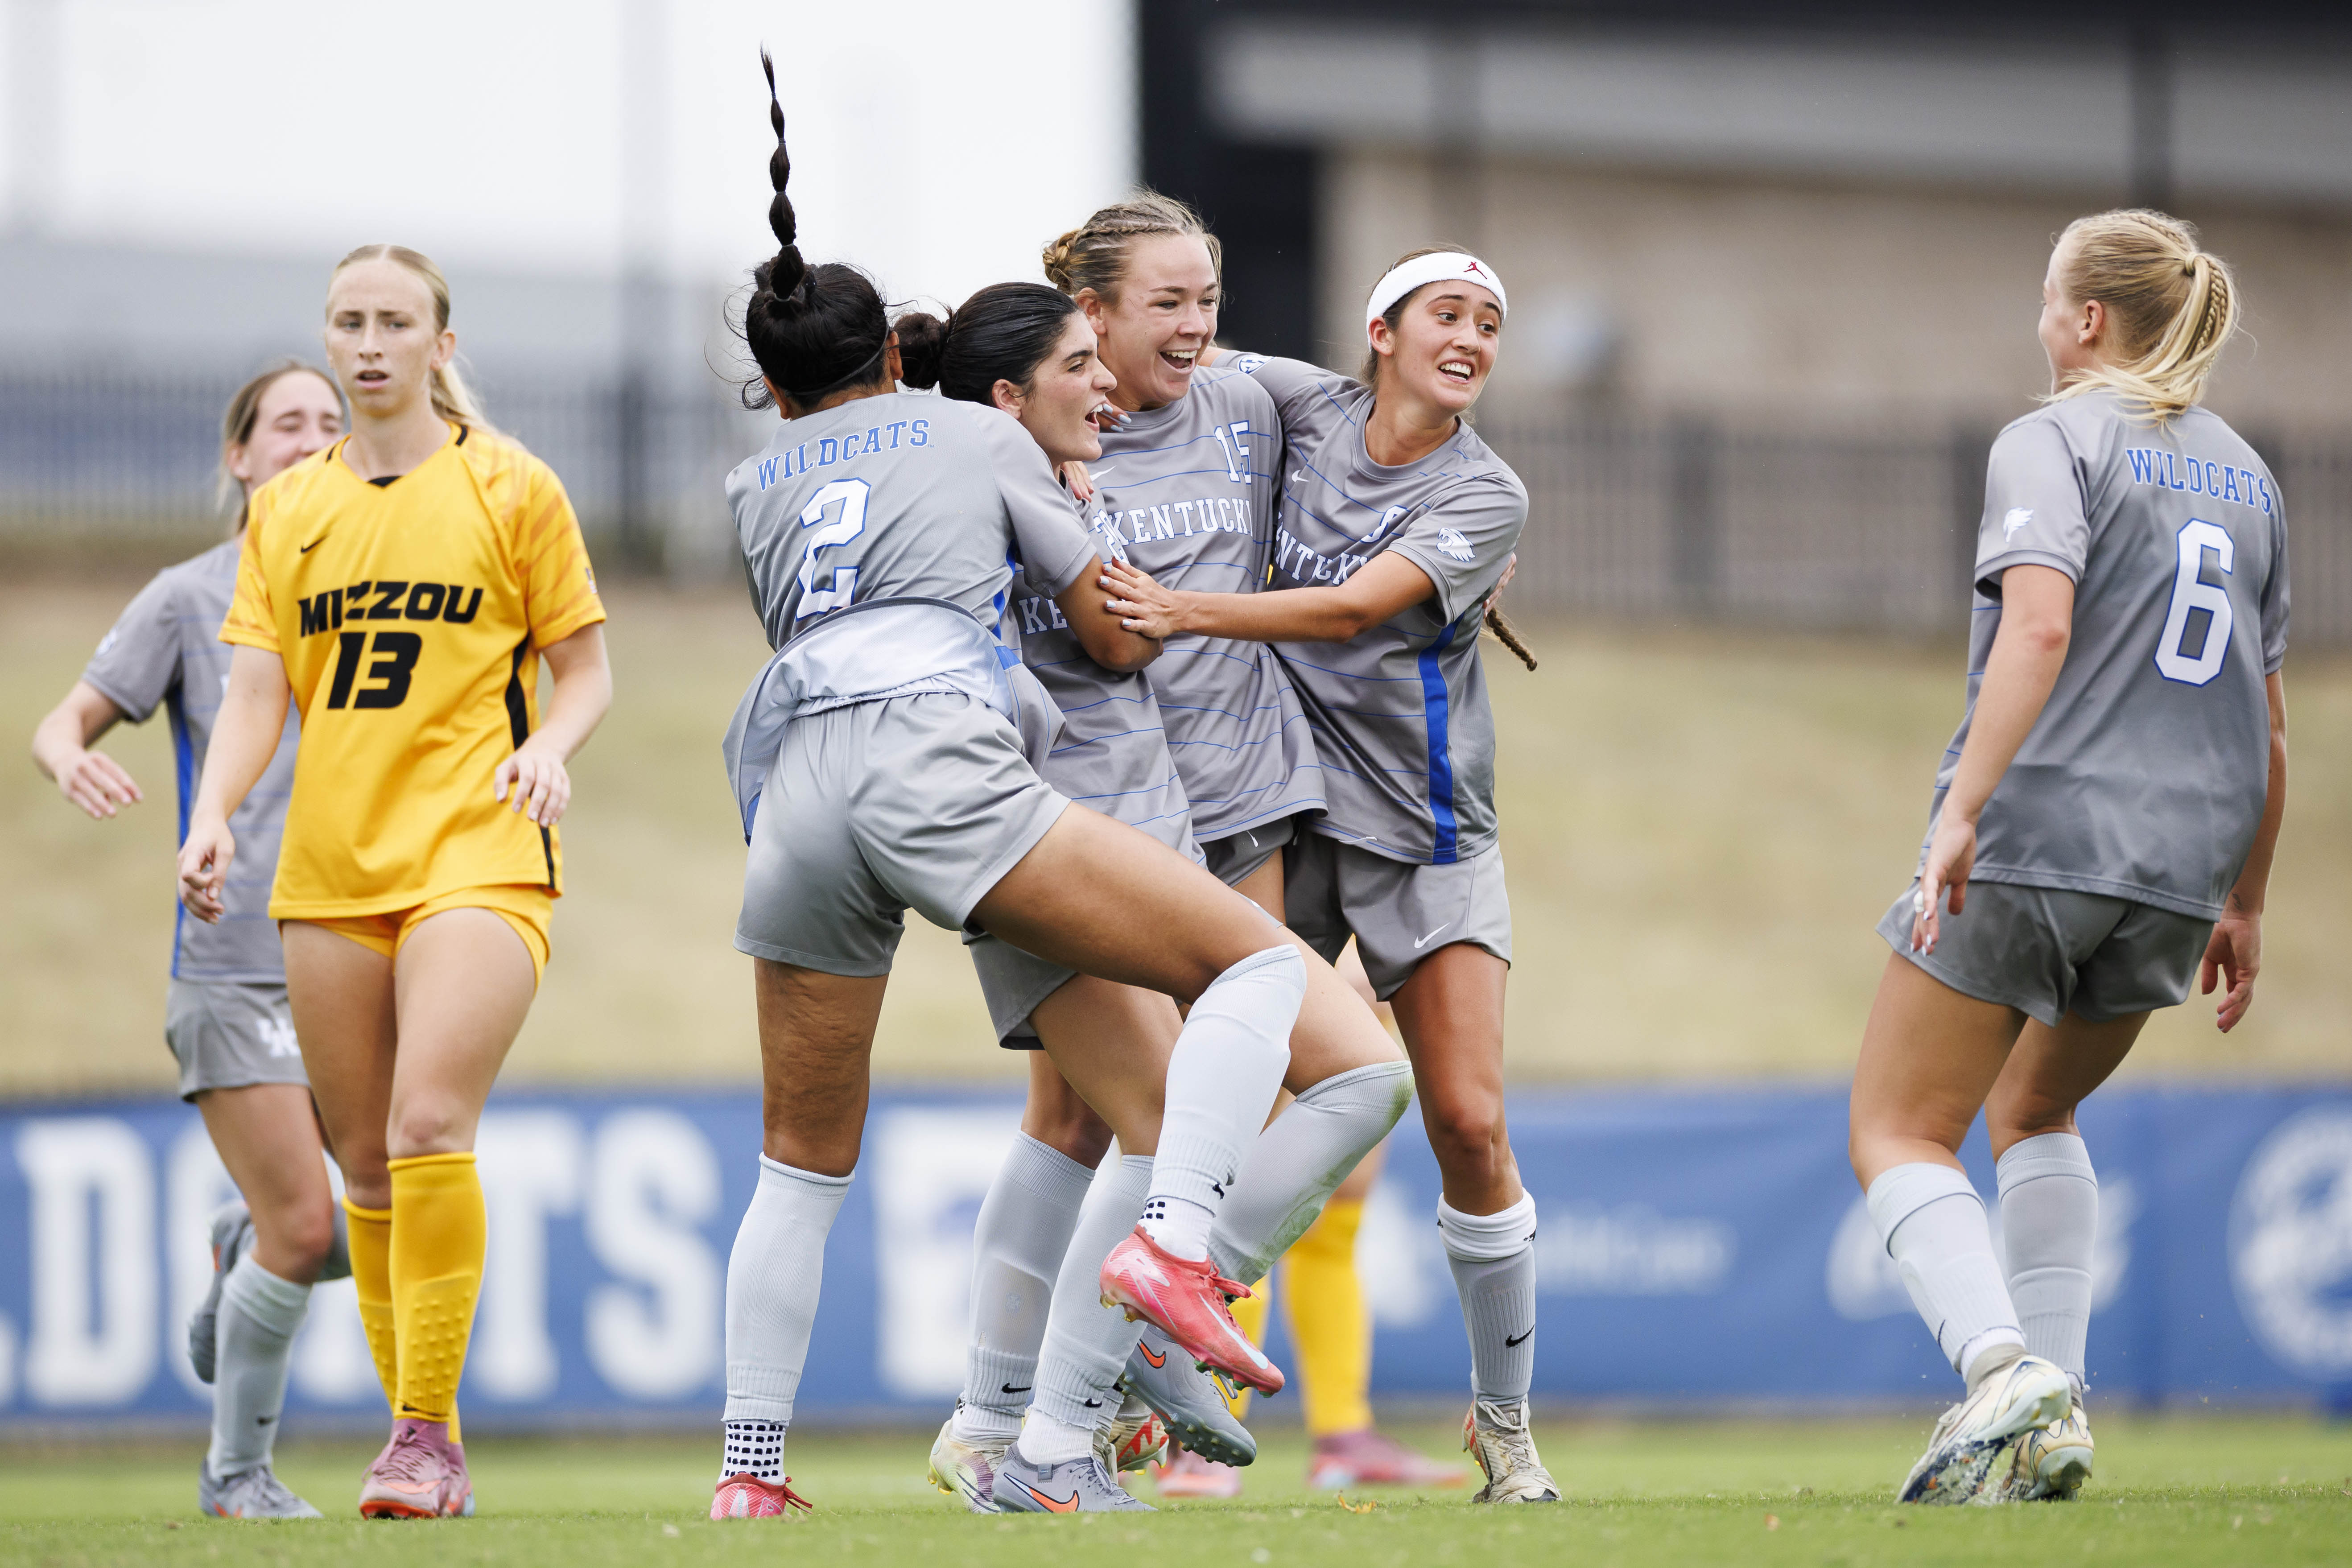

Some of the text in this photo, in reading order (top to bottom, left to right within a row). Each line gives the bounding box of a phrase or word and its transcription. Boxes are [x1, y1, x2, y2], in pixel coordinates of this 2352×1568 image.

[756, 418, 930, 492] WILDCATS
[1213, 420, 1252, 485] 15
[2126, 447, 2273, 516] WILDCATS
[795, 477, 871, 622] 2
[1106, 497, 1253, 546] KENTUCK
[298, 581, 483, 638] MIZZOU
[2153, 518, 2235, 688] 6
[327, 632, 422, 710] 13
